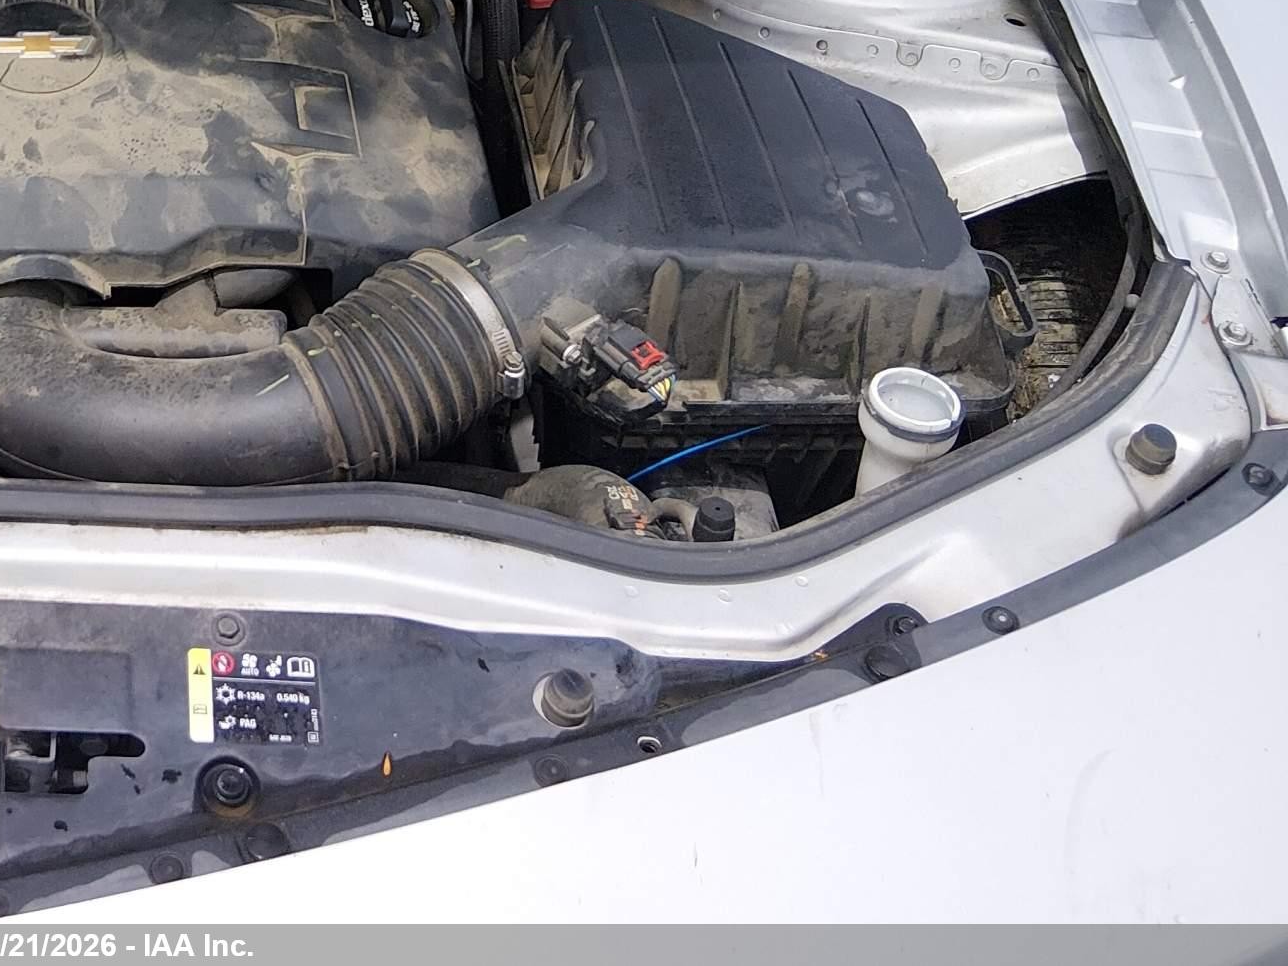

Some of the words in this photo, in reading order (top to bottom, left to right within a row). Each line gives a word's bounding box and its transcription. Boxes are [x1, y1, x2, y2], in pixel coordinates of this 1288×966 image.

[237, 691, 265, 701] R-134a
[298, 693, 310, 705] kg
[240, 718, 257, 729] PAG
